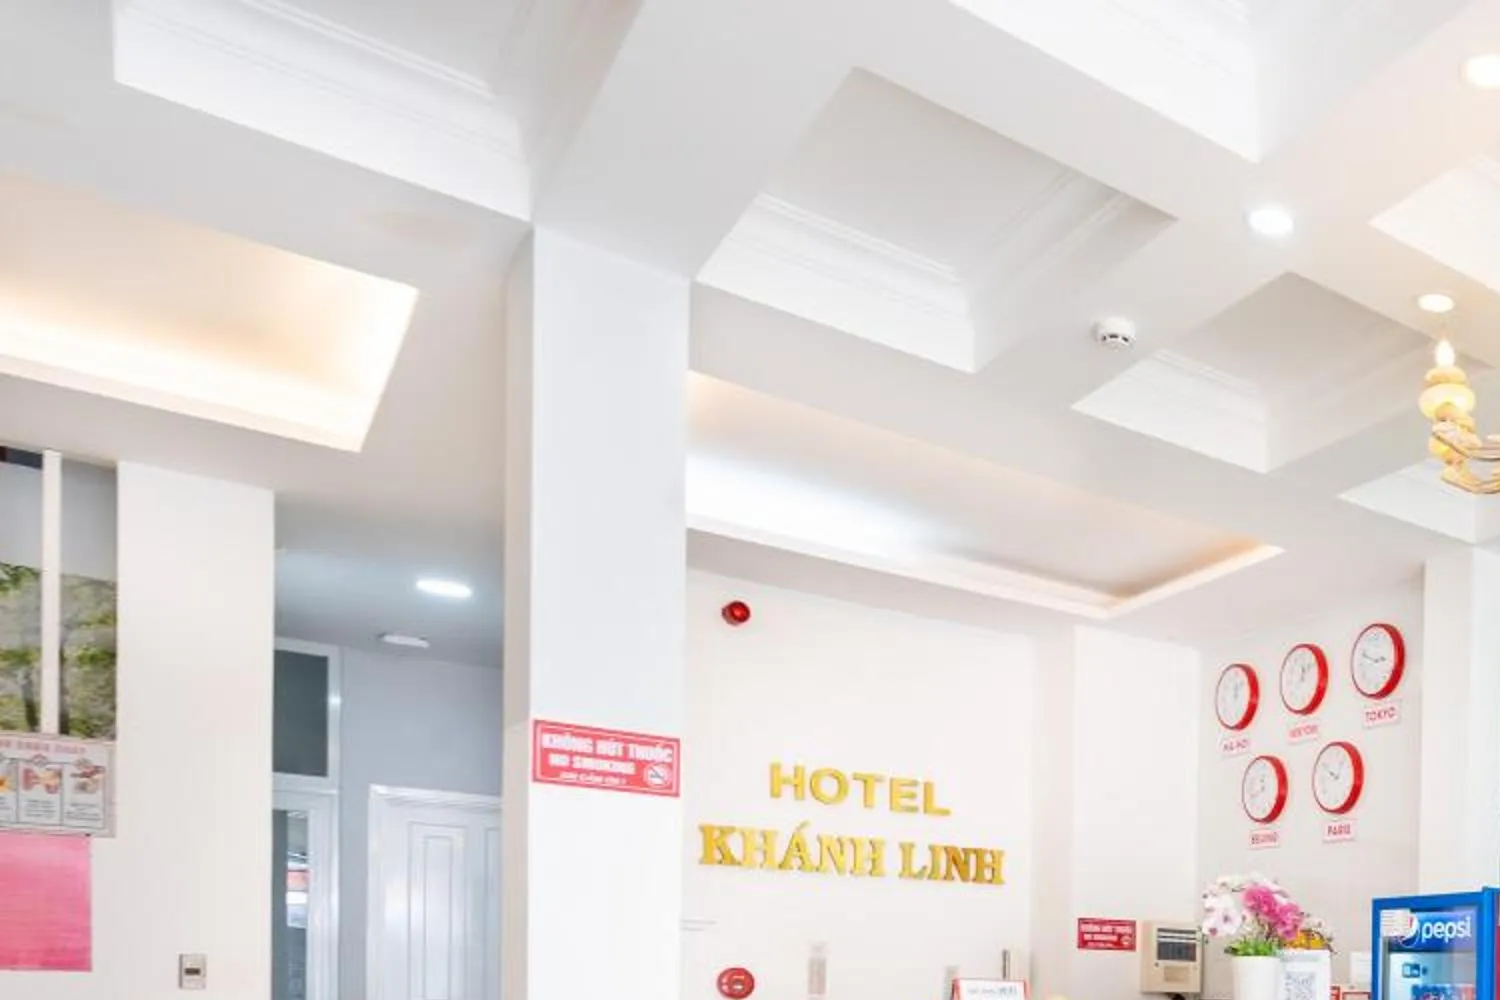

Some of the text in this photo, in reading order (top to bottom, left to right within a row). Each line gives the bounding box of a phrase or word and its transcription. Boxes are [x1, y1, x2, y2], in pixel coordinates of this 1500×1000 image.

[571, 755, 636, 775] SMOKING
[769, 762, 952, 817] HOTEL
[697, 820, 1006, 886] KHÁNH LINH
[1421, 915, 1472, 943] pepsi
